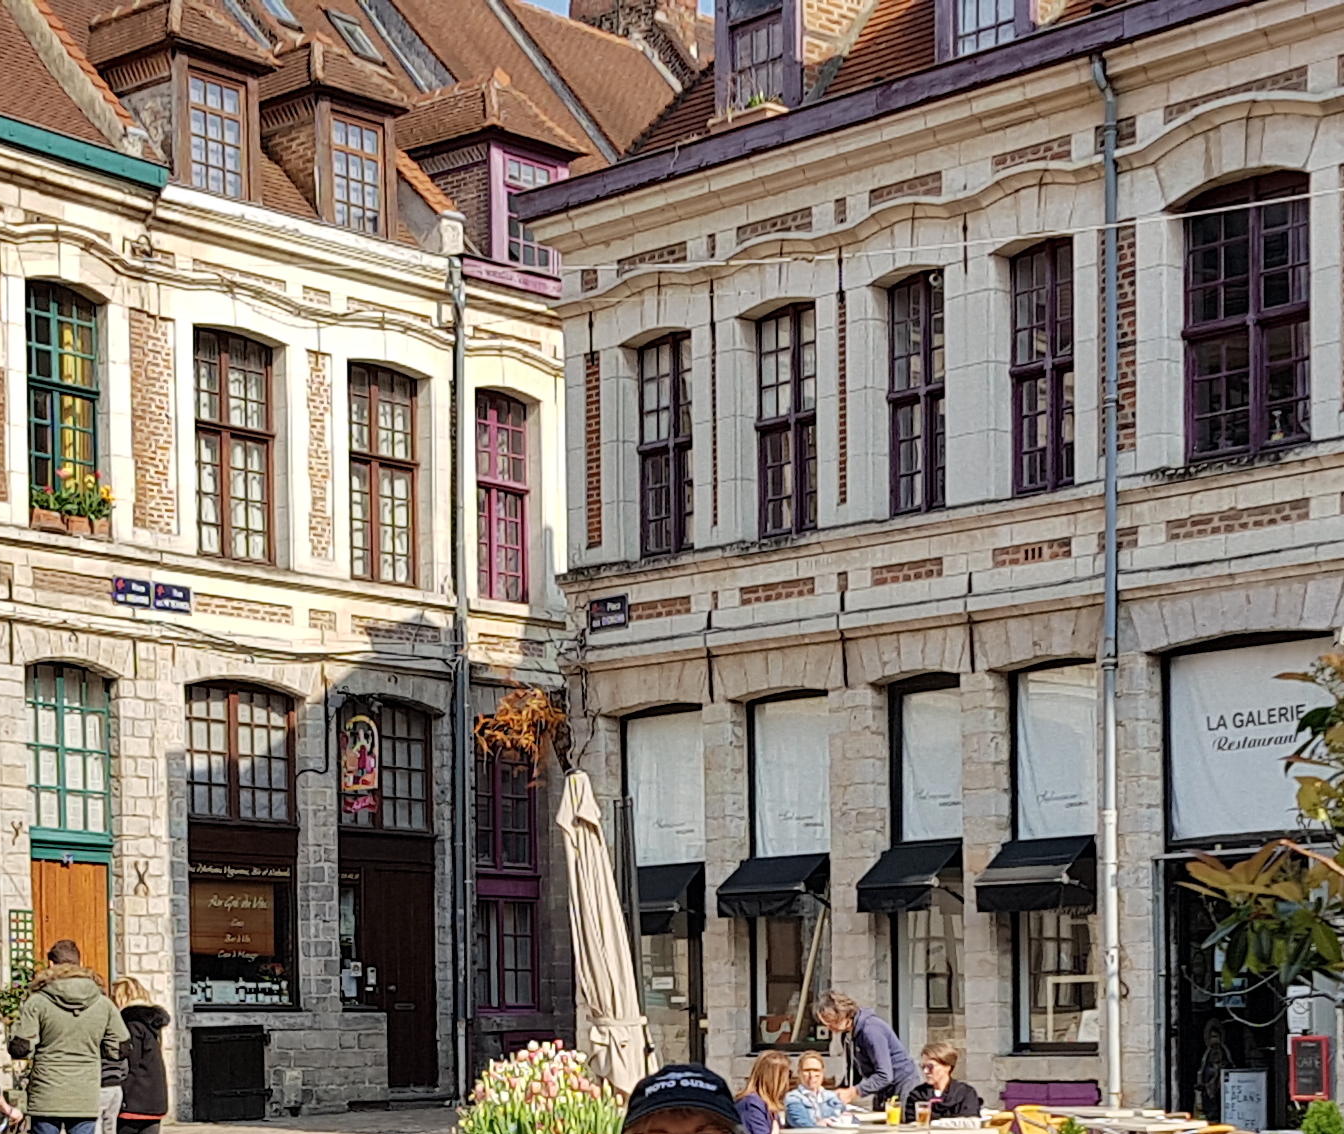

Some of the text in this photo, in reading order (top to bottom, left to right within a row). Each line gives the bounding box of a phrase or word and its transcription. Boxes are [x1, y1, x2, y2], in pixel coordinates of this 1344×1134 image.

[1206, 704, 1306, 731] LA GALERIE
[1212, 734, 1297, 751] Restaurant
